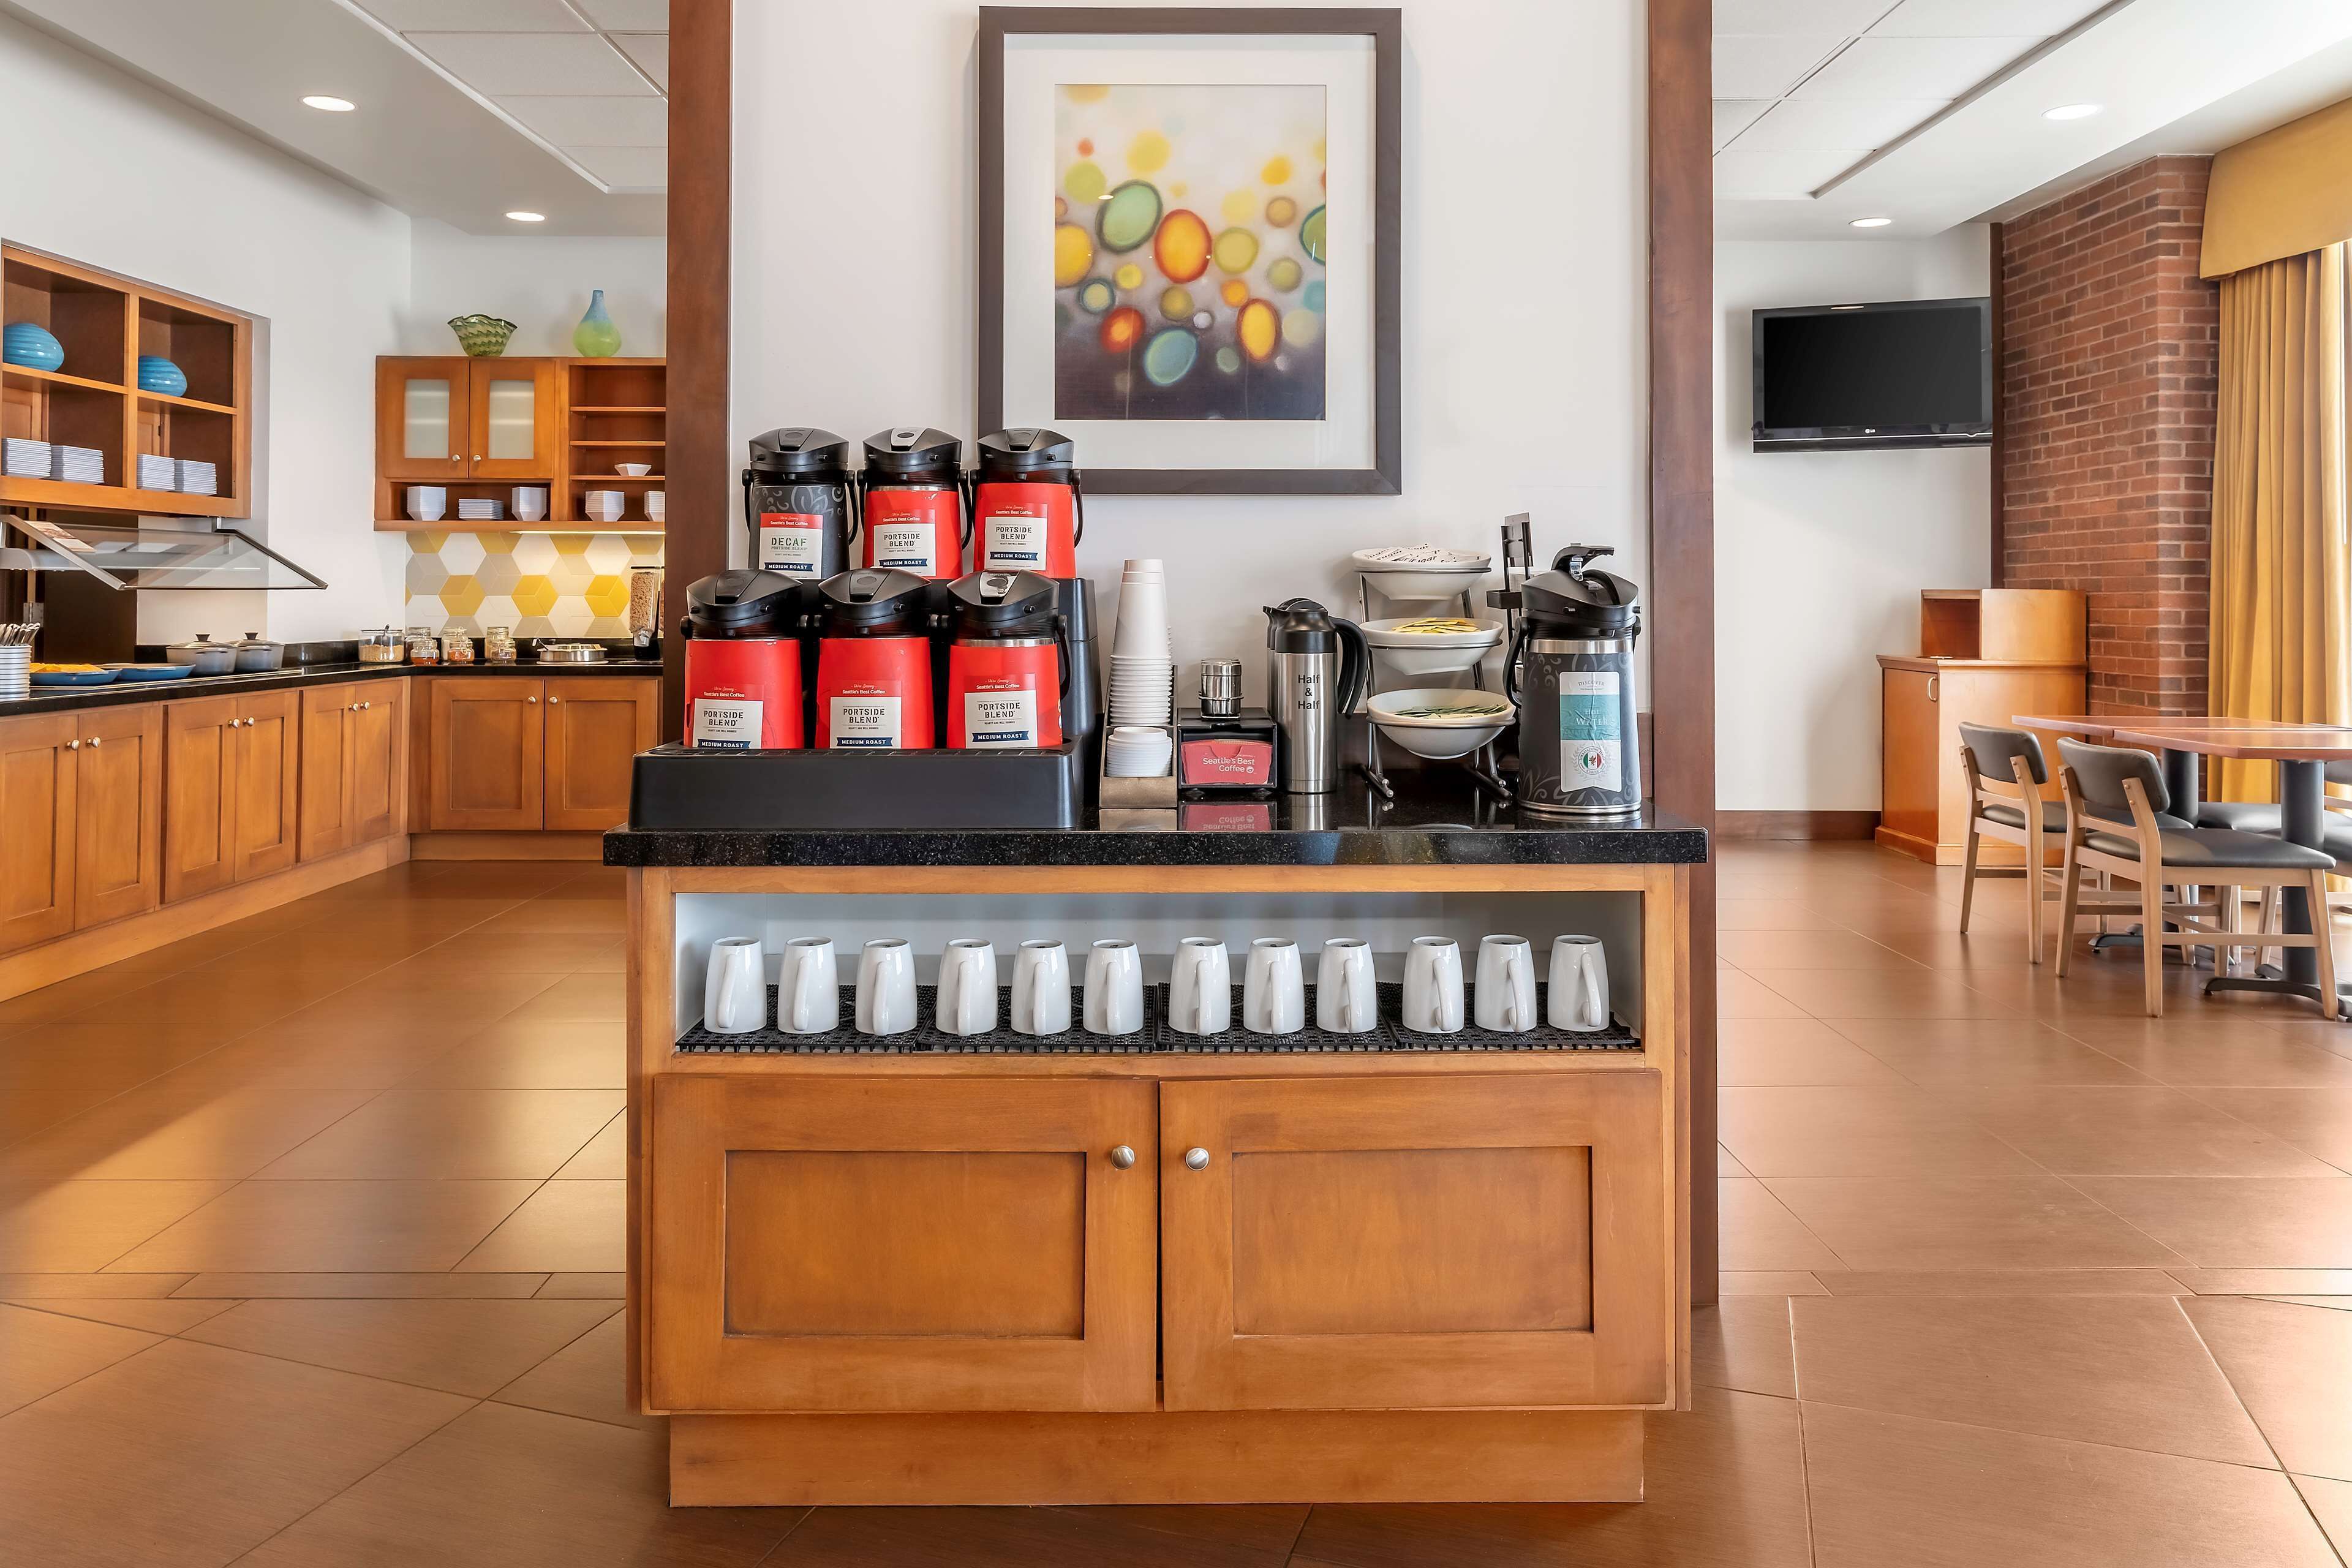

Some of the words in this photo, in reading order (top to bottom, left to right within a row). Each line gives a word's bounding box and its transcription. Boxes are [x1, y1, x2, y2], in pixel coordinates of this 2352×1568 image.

[771, 537, 807, 546] DECAF
[1298, 674, 1320, 684] Half
[1305, 688, 1313, 696] &
[1298, 701, 1320, 709] Half
[1576, 717, 1608, 725] WATER
